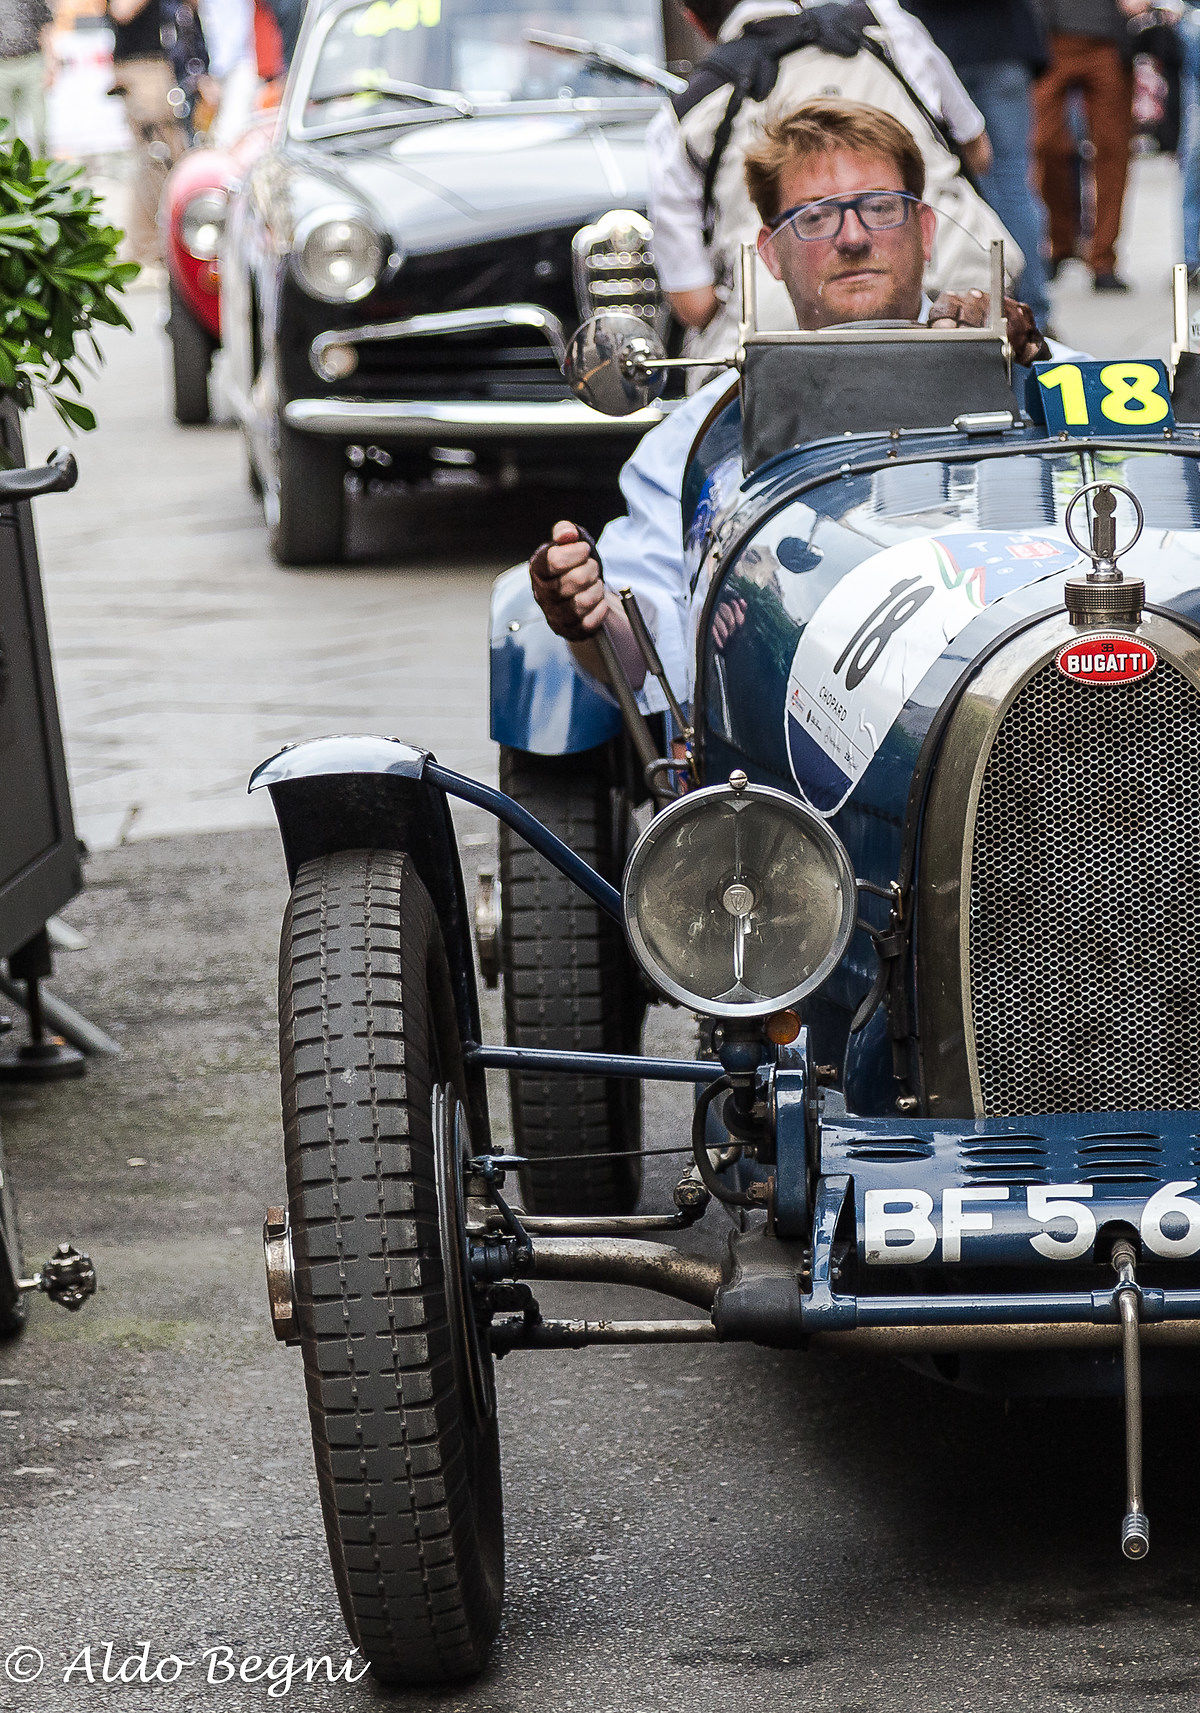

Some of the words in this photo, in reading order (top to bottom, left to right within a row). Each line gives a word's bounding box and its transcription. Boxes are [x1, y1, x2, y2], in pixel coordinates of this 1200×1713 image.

[1037, 363, 1169, 425] 18
[833, 575, 934, 691] 18
[1067, 653, 1148, 673] BUGATTI
[819, 686, 848, 721] CHOPARD
